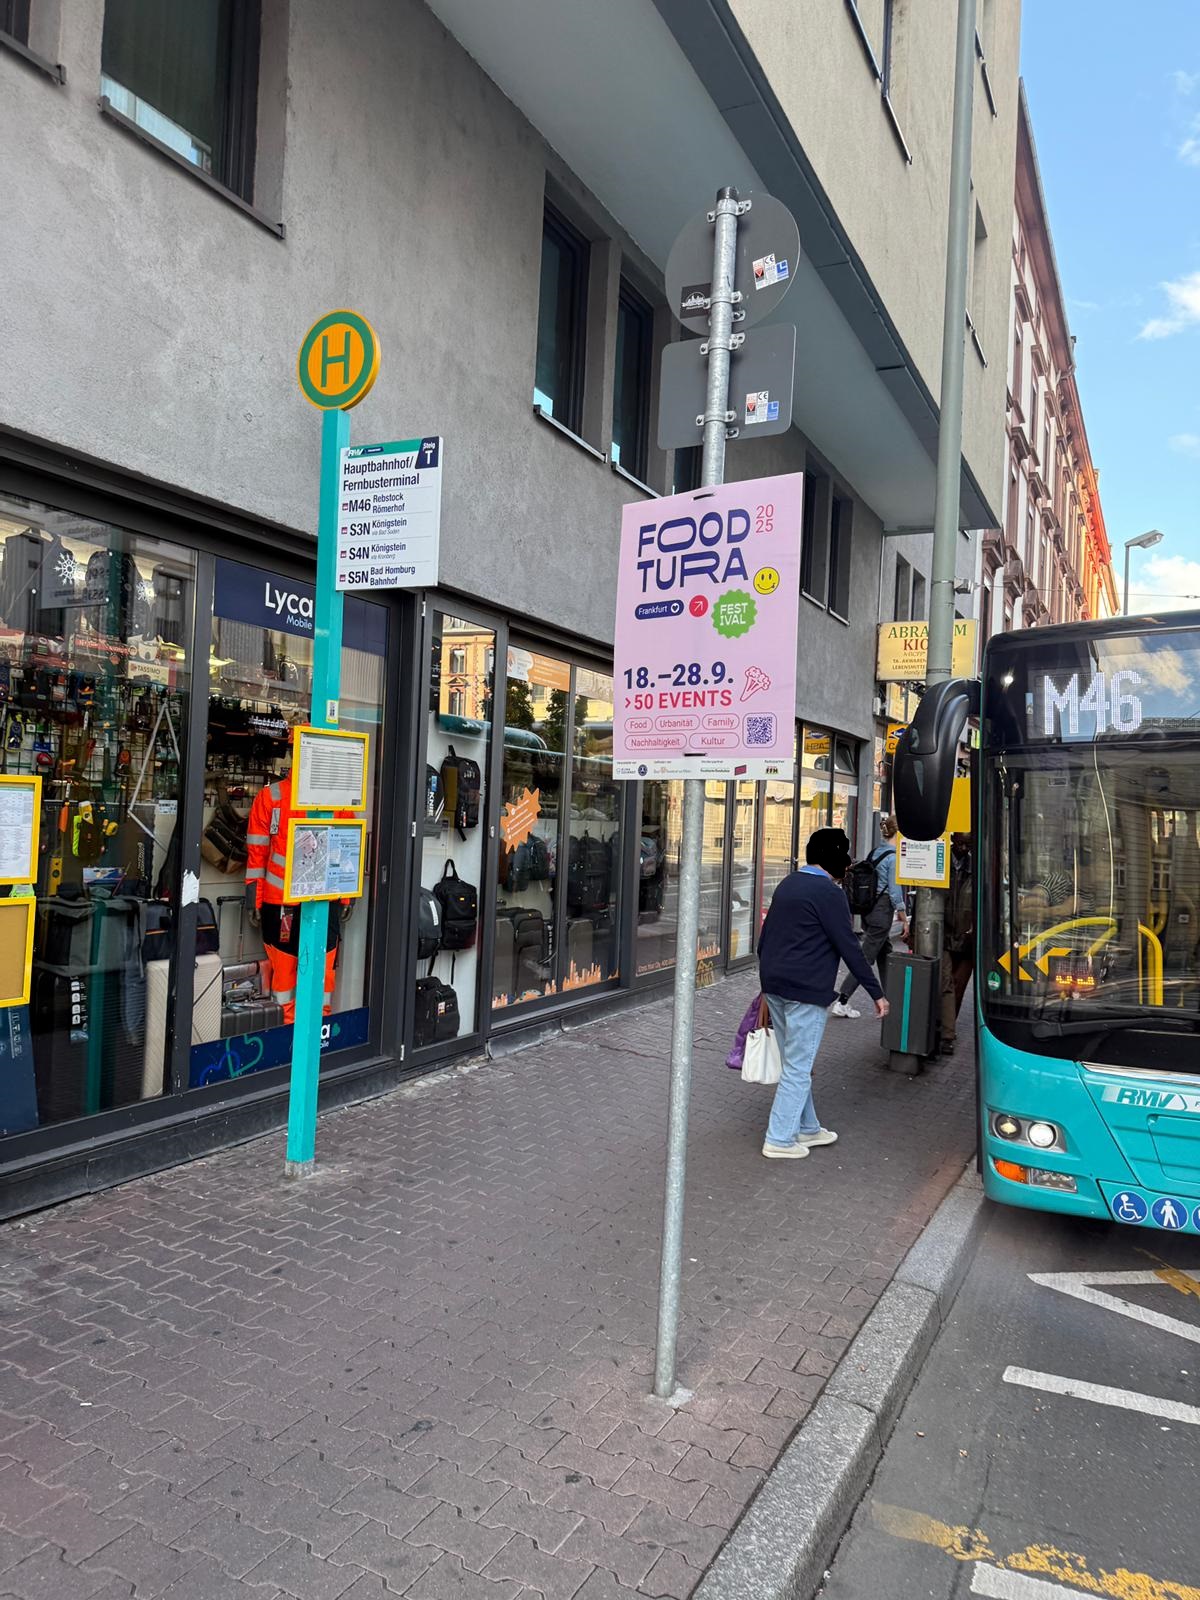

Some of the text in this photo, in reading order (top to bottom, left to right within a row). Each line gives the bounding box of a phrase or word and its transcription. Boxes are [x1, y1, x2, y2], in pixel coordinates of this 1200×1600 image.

[320, 331, 351, 388] H
[423, 441, 436, 451] Steig
[425, 450, 433, 465] T
[343, 456, 414, 476] Hauptbahnhof/
[343, 473, 420, 492] Fernbusterminal
[372, 492, 404, 503] Rebstock
[348, 498, 371, 513] M46
[372, 502, 406, 514] Römerhof
[756, 504, 774, 519] 20
[349, 522, 371, 536] S3N
[371, 517, 407, 529] Königstein
[755, 519, 774, 534] 25
[637, 508, 751, 558] FOOD
[348, 546, 370, 560] S4N
[371, 542, 407, 554] Königstein
[348, 570, 369, 584] S5N
[370, 565, 416, 576] Bad Homburg
[637, 547, 749, 593] TURA
[370, 576, 398, 586] Bahnhof
[264, 582, 313, 617] Lyca
[638, 605, 668, 616] Frankfurt
[720, 602, 749, 614] FEST
[286, 614, 313, 630] Mobile
[719, 614, 747, 626] IVAL
[888, 623, 967, 639] ABRAM
[137, 665, 161, 675] TASSIMO
[658, 689, 733, 709] EVENTS
[1043, 670, 1143, 736] M46
[630, 720, 647, 729] Food
[659, 718, 693, 728] Urbanität
[707, 717, 735, 728] Family
[630, 736, 681, 748] Nachhaltigkeit
[701, 735, 726, 746] Kultur
[1116, 1087, 1177, 1109] RMV
